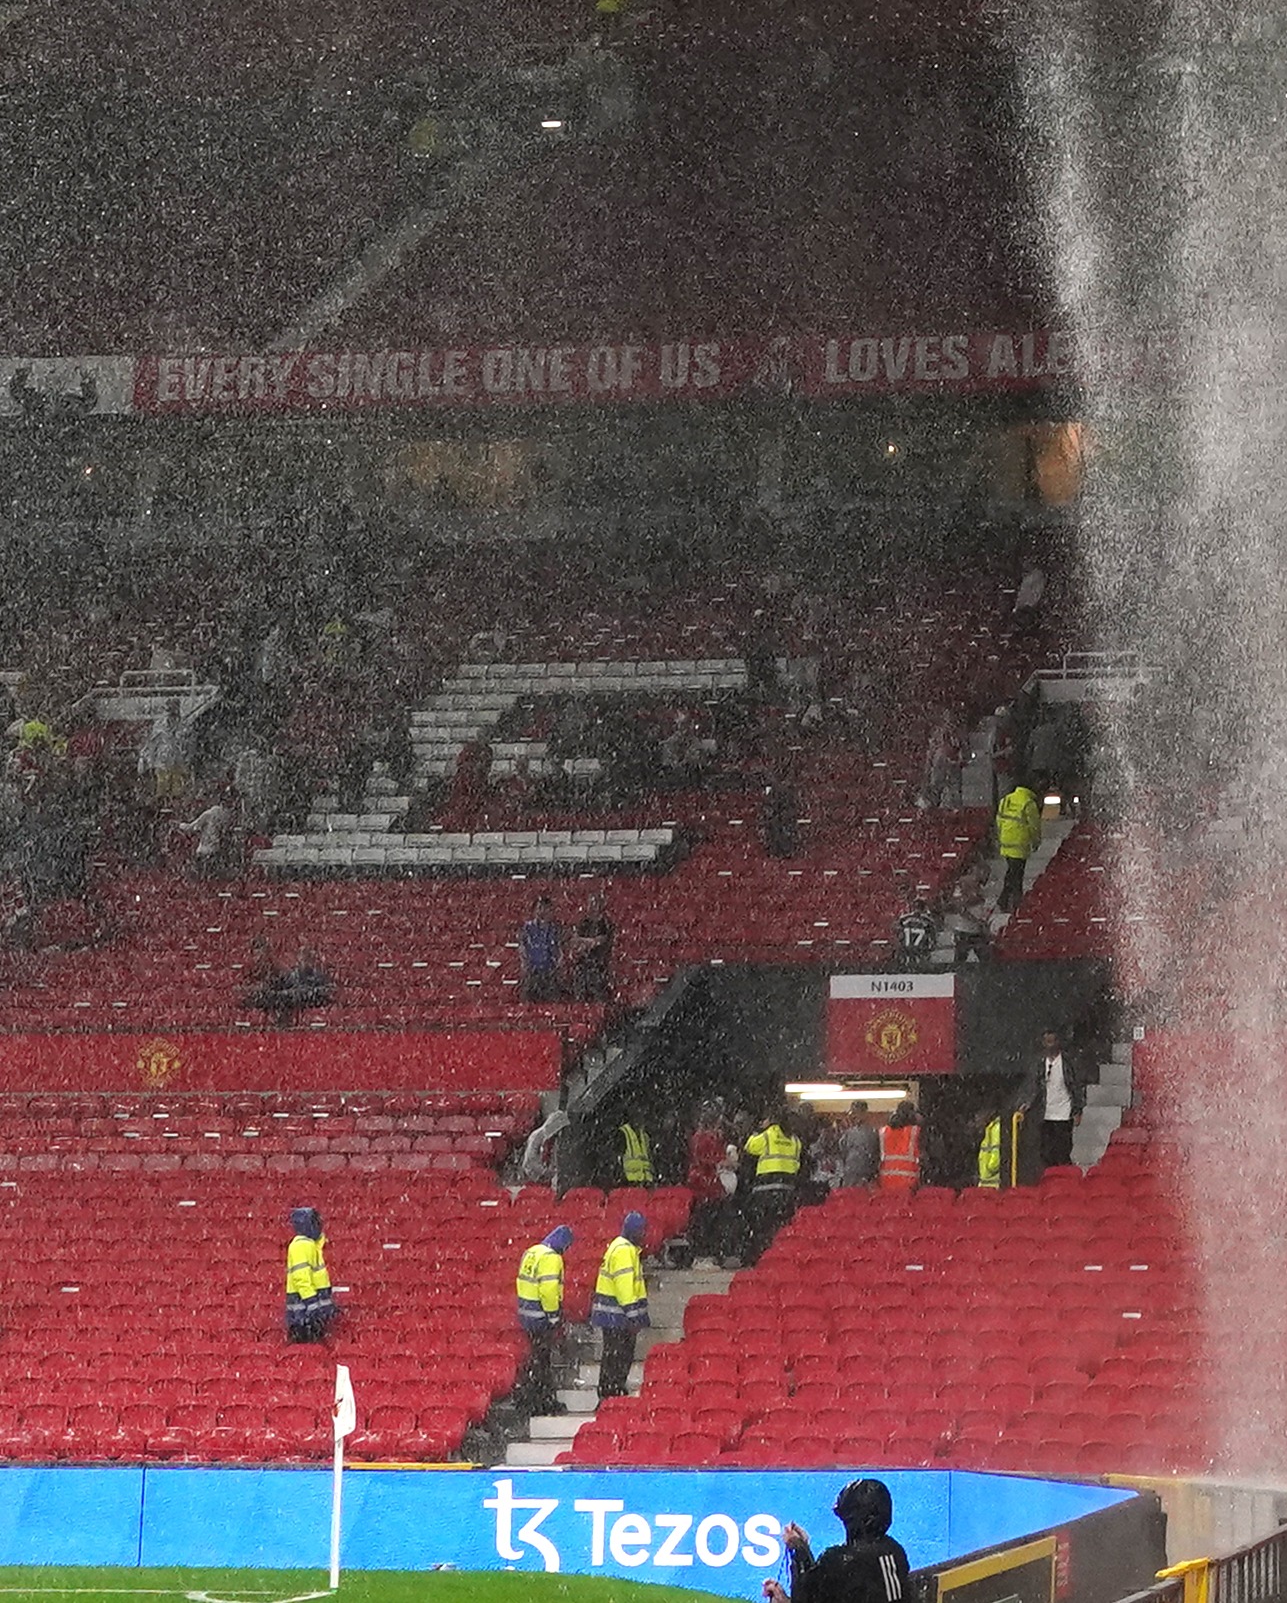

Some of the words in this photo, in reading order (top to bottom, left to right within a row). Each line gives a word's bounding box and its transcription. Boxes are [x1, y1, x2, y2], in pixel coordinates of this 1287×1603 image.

[157, 354, 294, 401] EVERY
[307, 349, 468, 398] SINGLE
[482, 346, 572, 393] ONE
[587, 344, 643, 391] OF
[659, 341, 721, 388] US
[825, 334, 969, 383] LOVES
[903, 928, 925, 947] 17
[871, 981, 914, 992] N1403
[574, 1498, 781, 1567] Tezos
